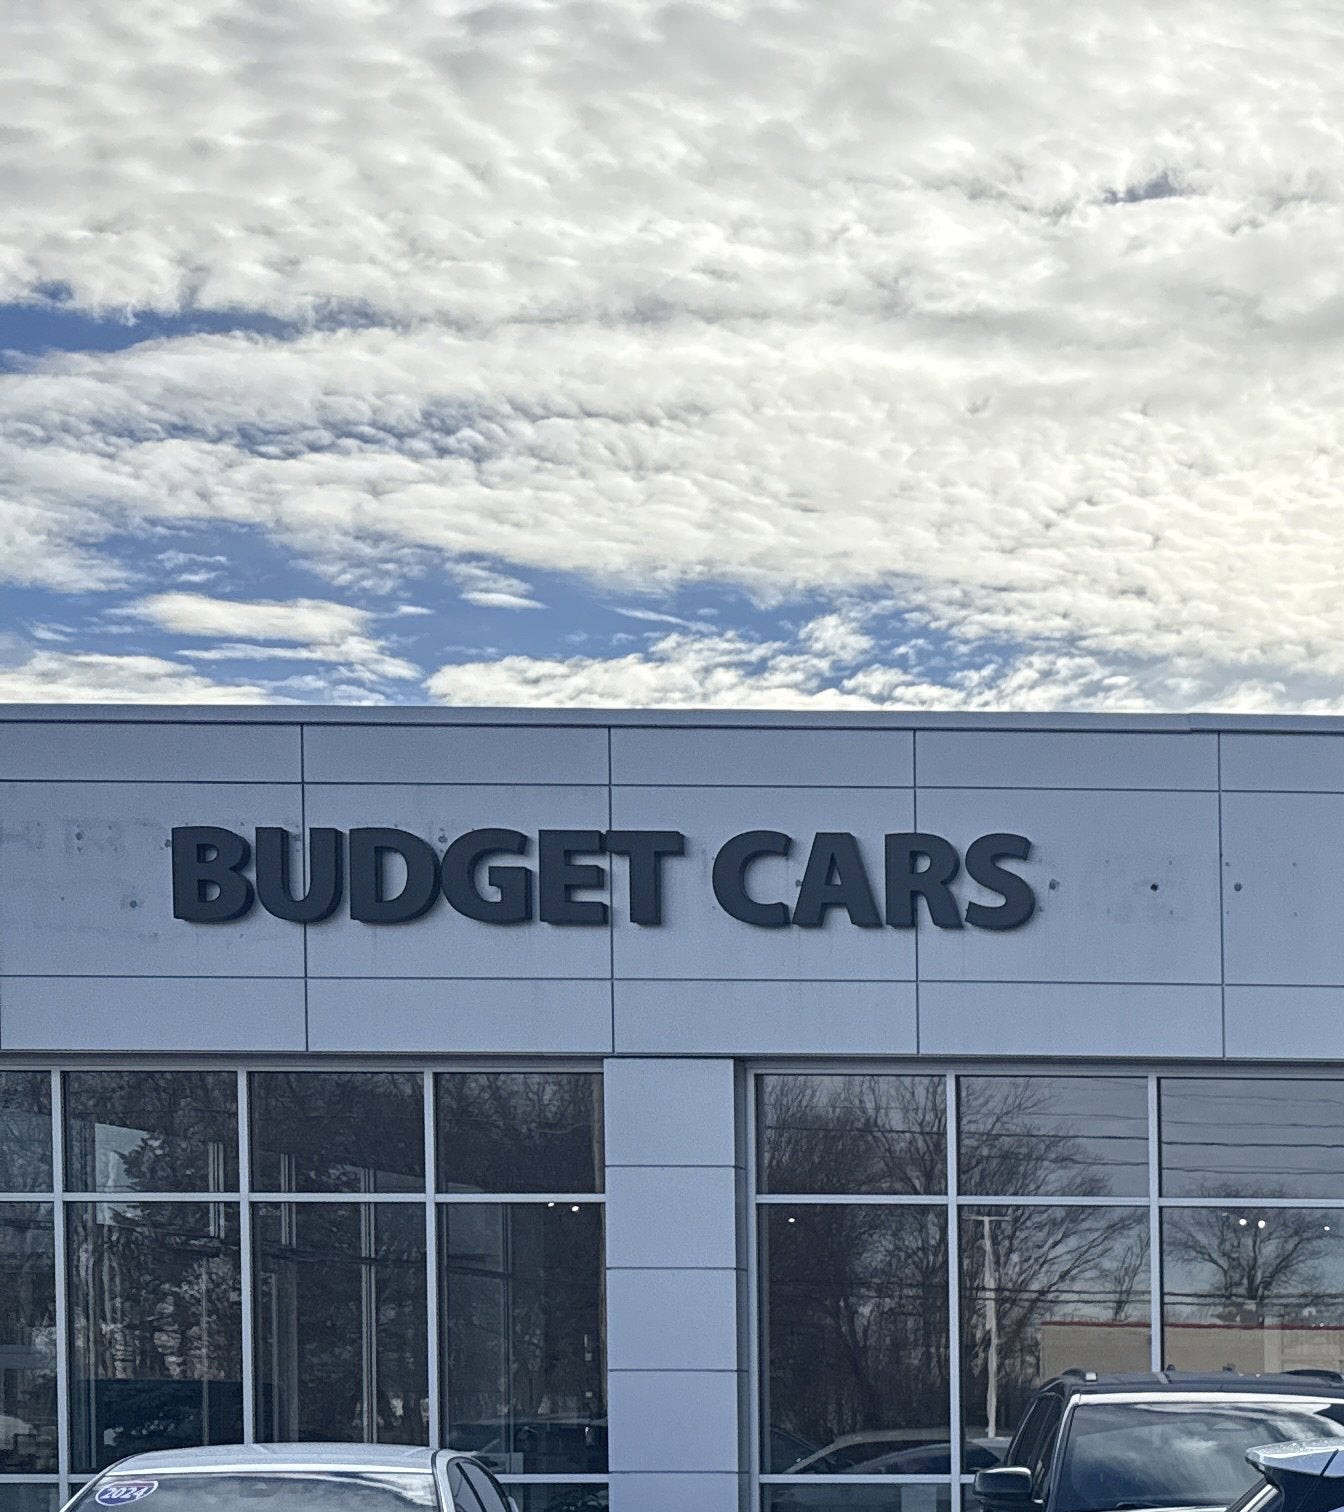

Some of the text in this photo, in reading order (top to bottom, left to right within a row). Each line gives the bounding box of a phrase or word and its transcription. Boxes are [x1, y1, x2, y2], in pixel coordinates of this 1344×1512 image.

[170, 826, 1038, 929] BUDGET CARS
[100, 1486, 149, 1499] 2024
